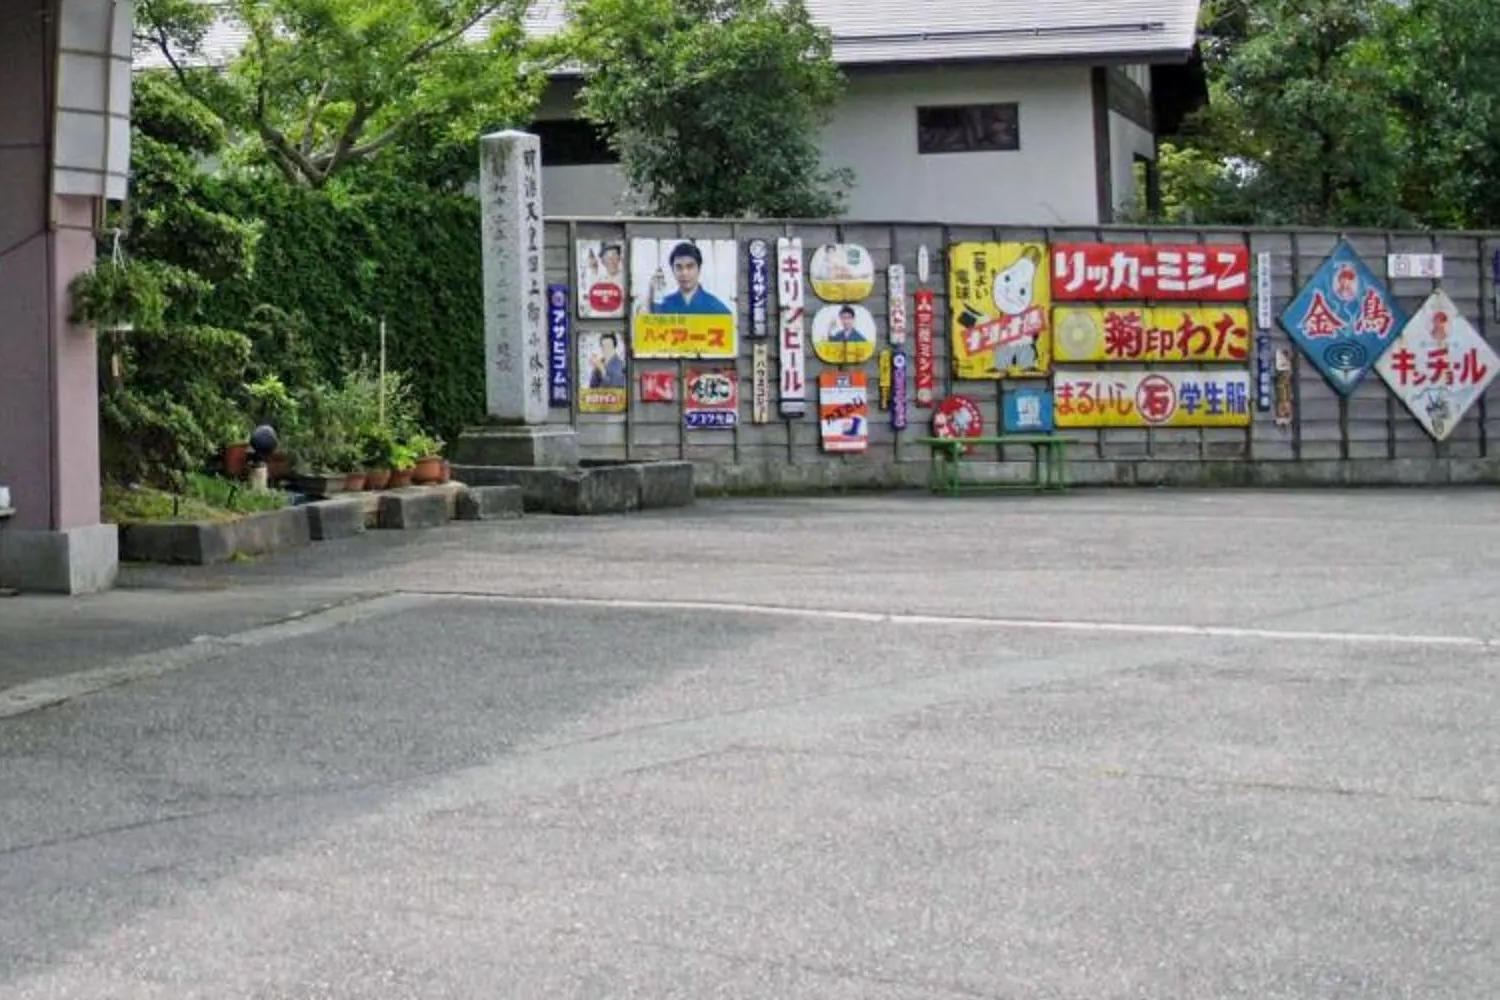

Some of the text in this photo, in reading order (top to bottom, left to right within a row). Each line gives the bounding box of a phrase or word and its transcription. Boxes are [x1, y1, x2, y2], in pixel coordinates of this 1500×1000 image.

[1054, 251, 1246, 292] リッカーミシン
[1300, 288, 1396, 340] 金鳥
[643, 326, 725, 348] ハイアース
[1103, 310, 1248, 359] 菊印わた
[1391, 347, 1487, 386] キンチョール
[691, 377, 731, 400] たばこ
[1054, 381, 1134, 416] まるいし
[1179, 381, 1247, 416] 学生服
